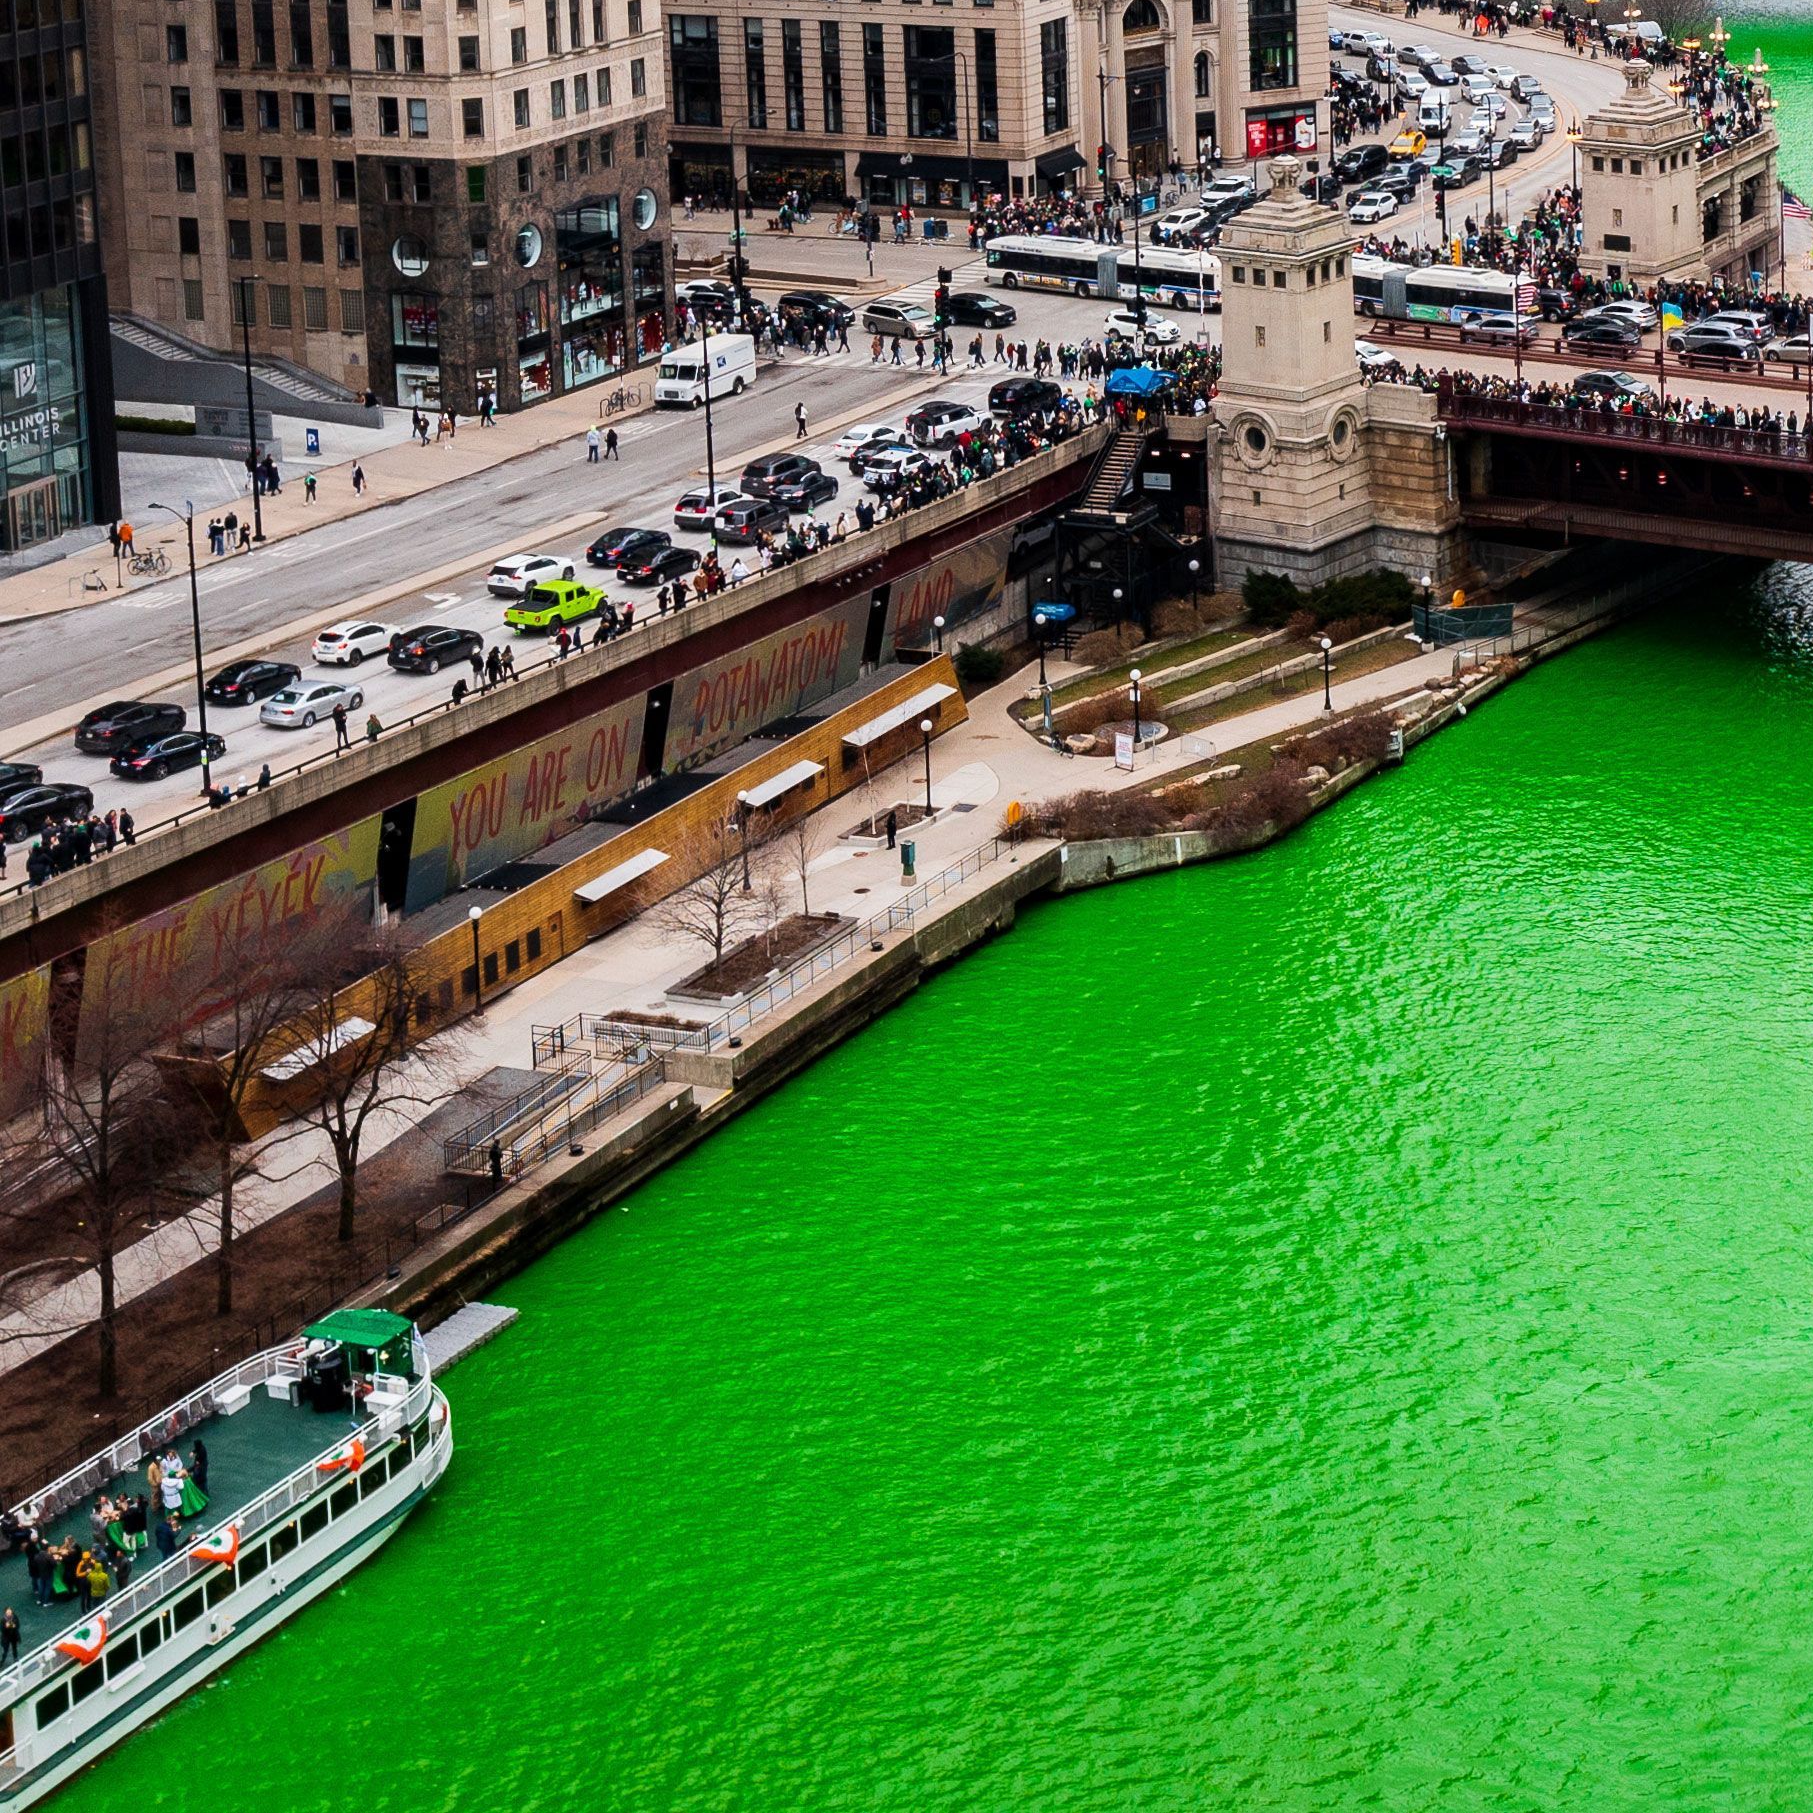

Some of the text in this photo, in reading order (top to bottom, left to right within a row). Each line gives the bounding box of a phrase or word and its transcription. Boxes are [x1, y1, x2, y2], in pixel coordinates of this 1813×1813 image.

[0, 422, 60, 453] CENTER
[895, 568, 954, 648] LAND
[690, 619, 846, 746] POTAWATOMI
[450, 718, 630, 861] YOU ARE ON
